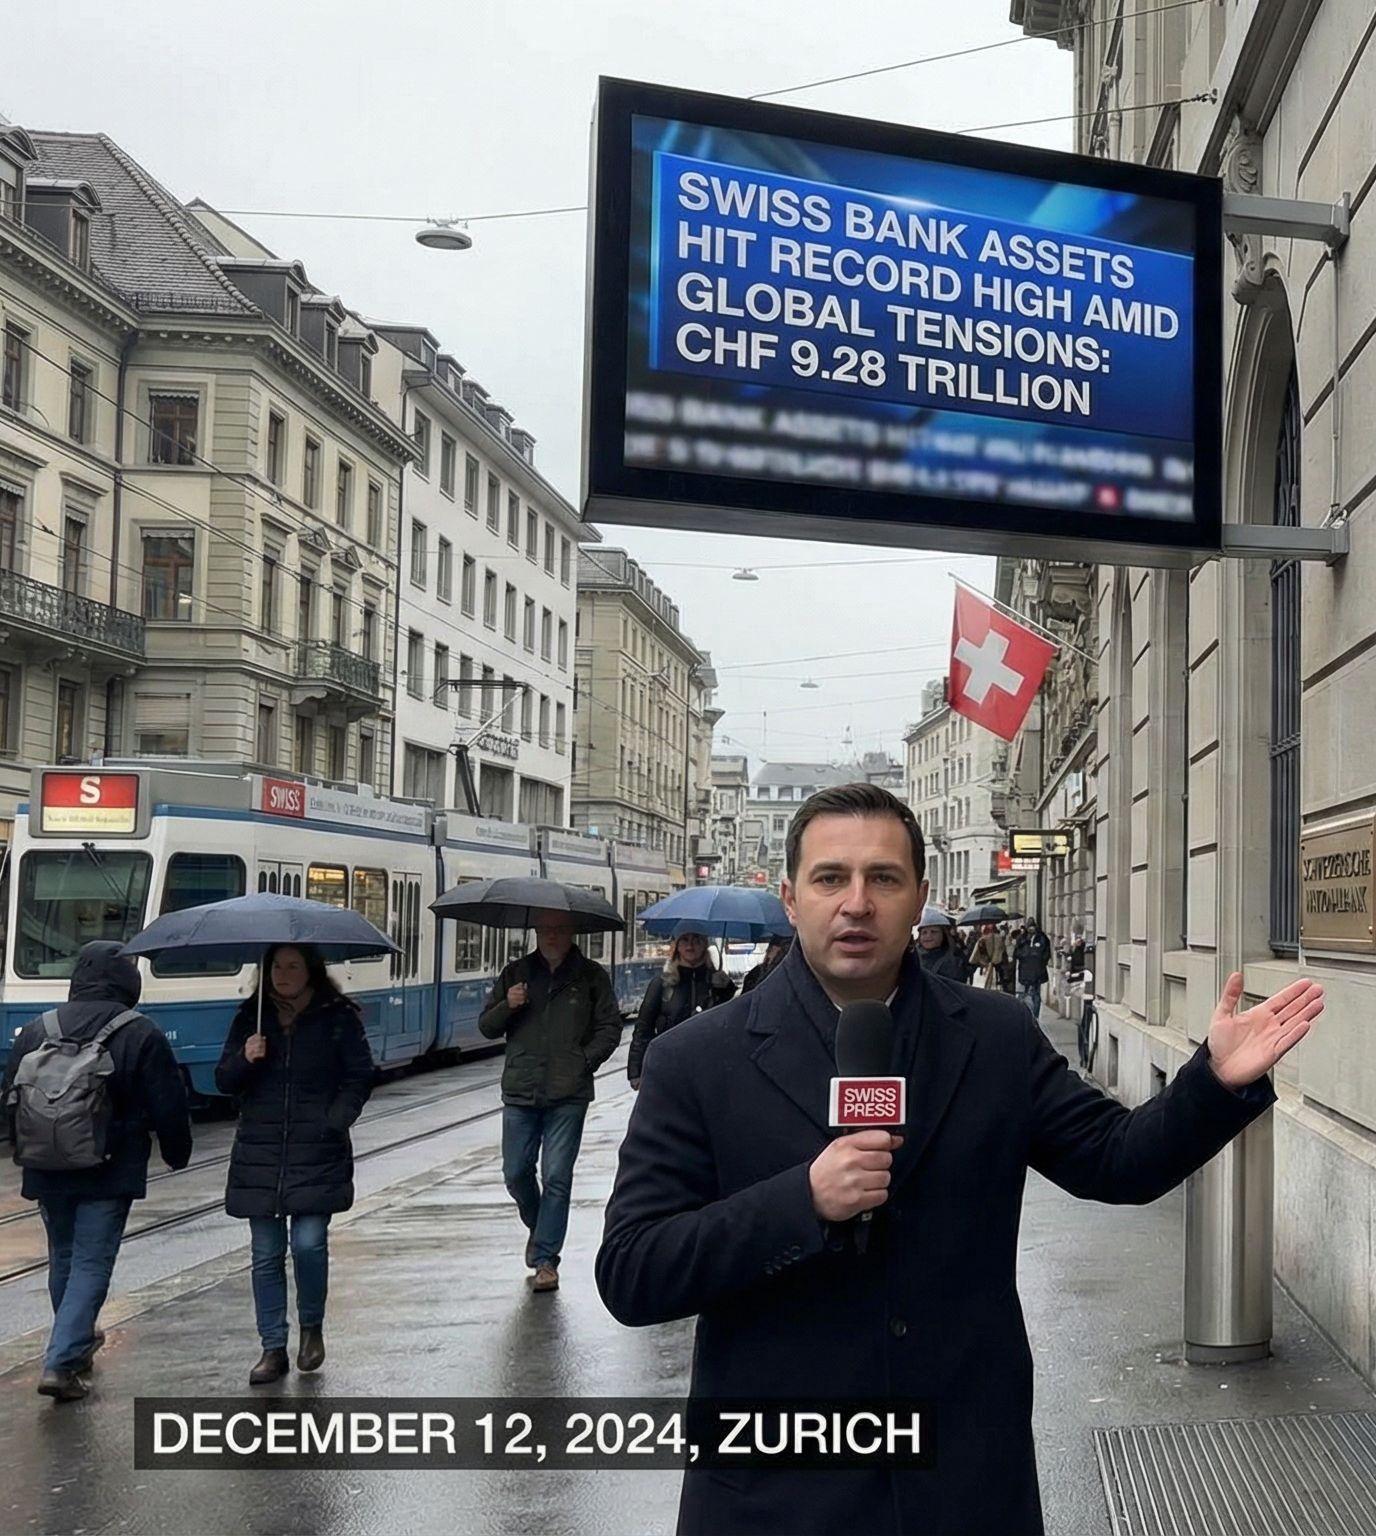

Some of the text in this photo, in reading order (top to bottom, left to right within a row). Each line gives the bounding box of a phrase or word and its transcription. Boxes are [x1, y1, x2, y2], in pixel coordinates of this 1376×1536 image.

[677, 171, 1135, 289] SWISS BANK ASSETS
[677, 221, 1179, 340] HIT RECORD HIGH AMID
[676, 271, 1111, 374] GLOBAL TENSIONS:
[675, 322, 1091, 416] CHF 9.28 TRILLION
[80, 776, 101, 804] S
[270, 786, 300, 811] SWISS
[844, 1088, 897, 1102] SWISS
[844, 1103, 897, 1117] PRESS
